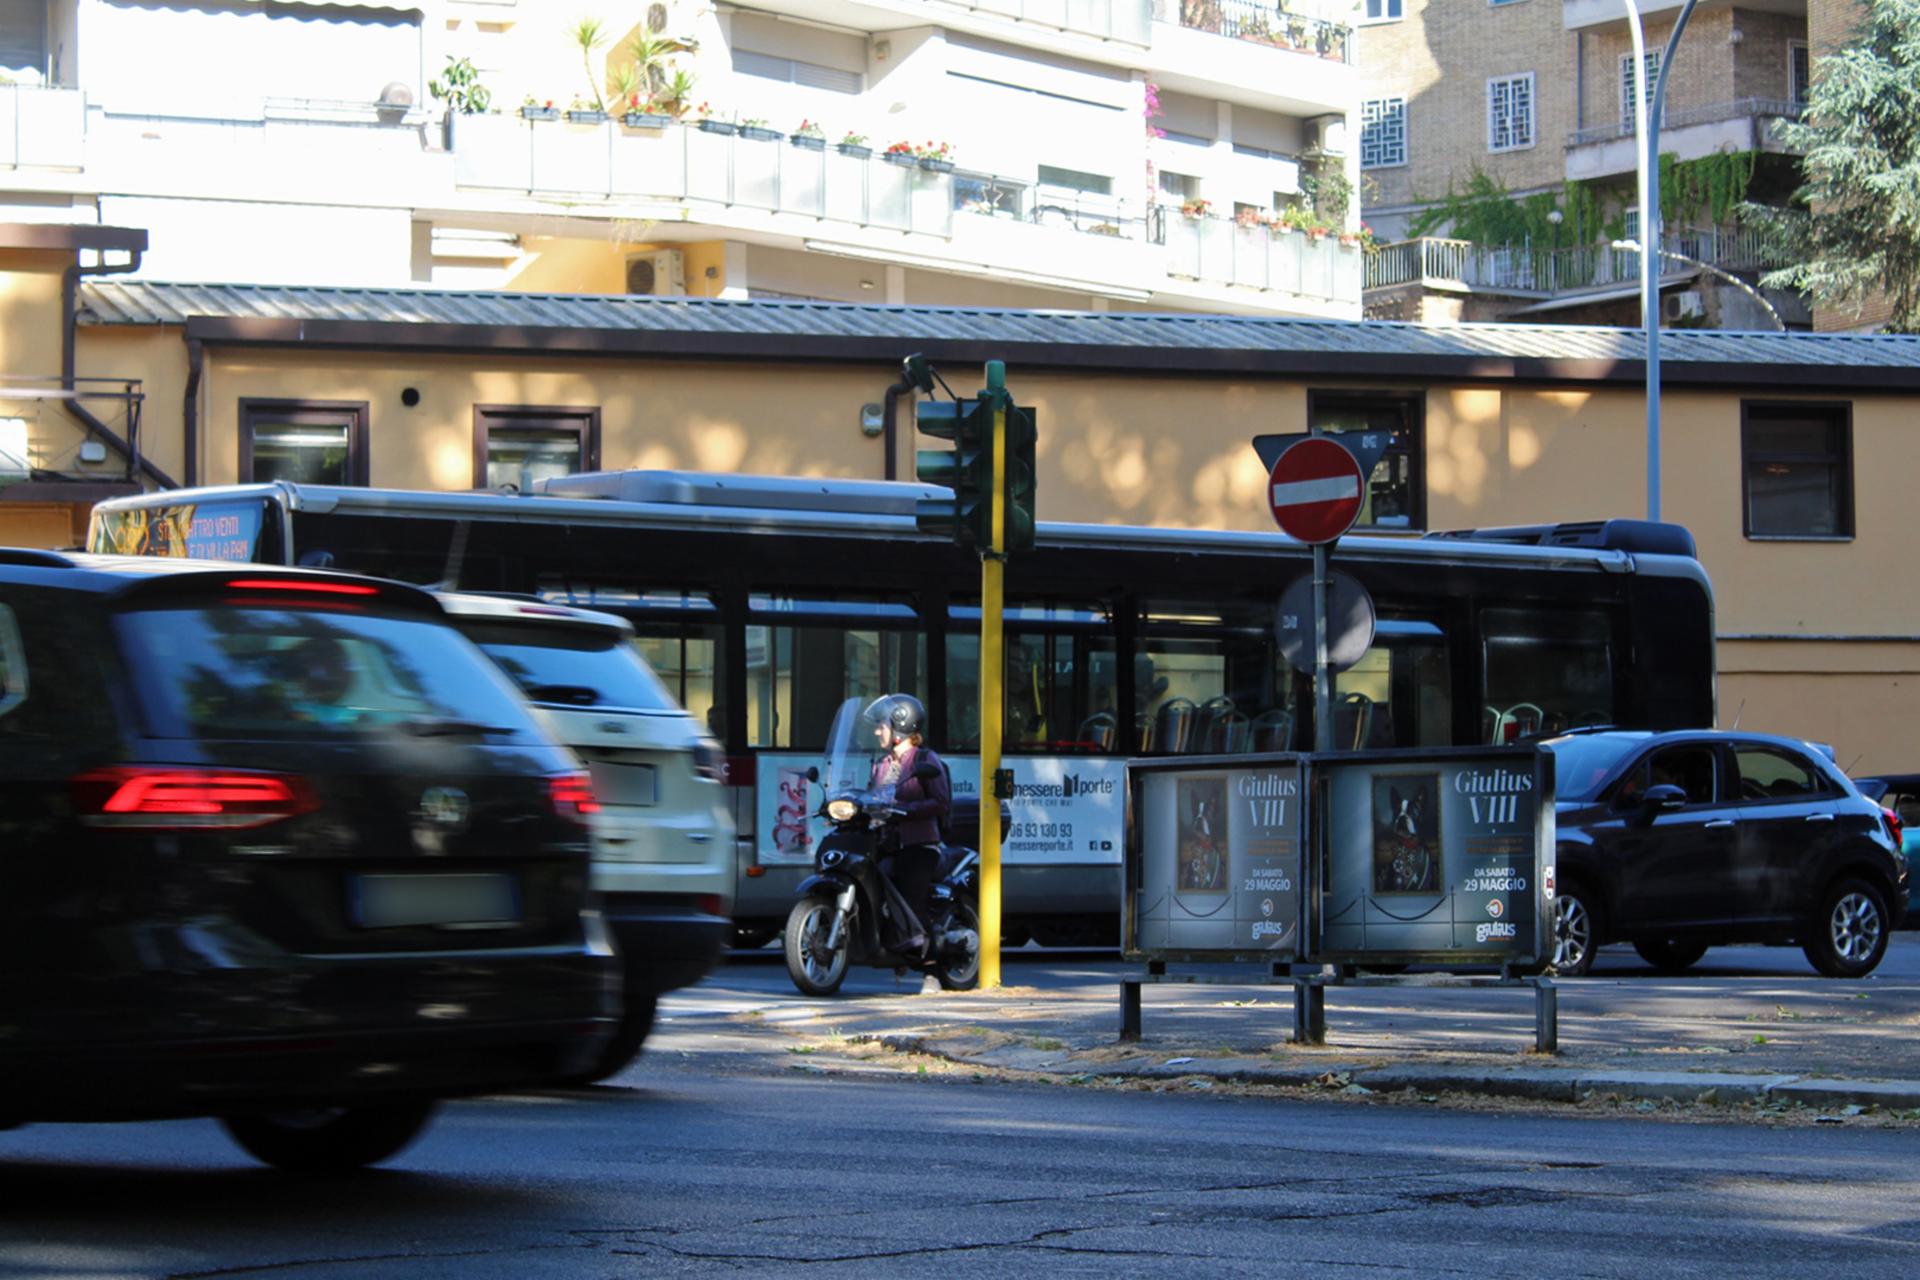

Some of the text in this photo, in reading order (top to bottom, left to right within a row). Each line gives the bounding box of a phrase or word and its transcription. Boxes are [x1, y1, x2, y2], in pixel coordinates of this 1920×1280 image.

[953, 780, 976, 792] usta.
[1079, 778, 1113, 797] porte
[1239, 774, 1296, 797] Giulius
[1454, 769, 1533, 793] Giulius
[1249, 800, 1285, 827] VIII
[1469, 795, 1518, 824] VIII
[1010, 823, 1073, 838] 06 93 130 93
[1009, 839, 1074, 853] messereporte.it
[1252, 868, 1284, 878] DA SABATO
[1474, 867, 1516, 877] DA SABATO
[1244, 879, 1291, 891] 29 MAGGIO
[1464, 878, 1526, 891] 29 MAGGIO
[1251, 920, 1283, 940] giulius
[1476, 921, 1516, 942] giulius
